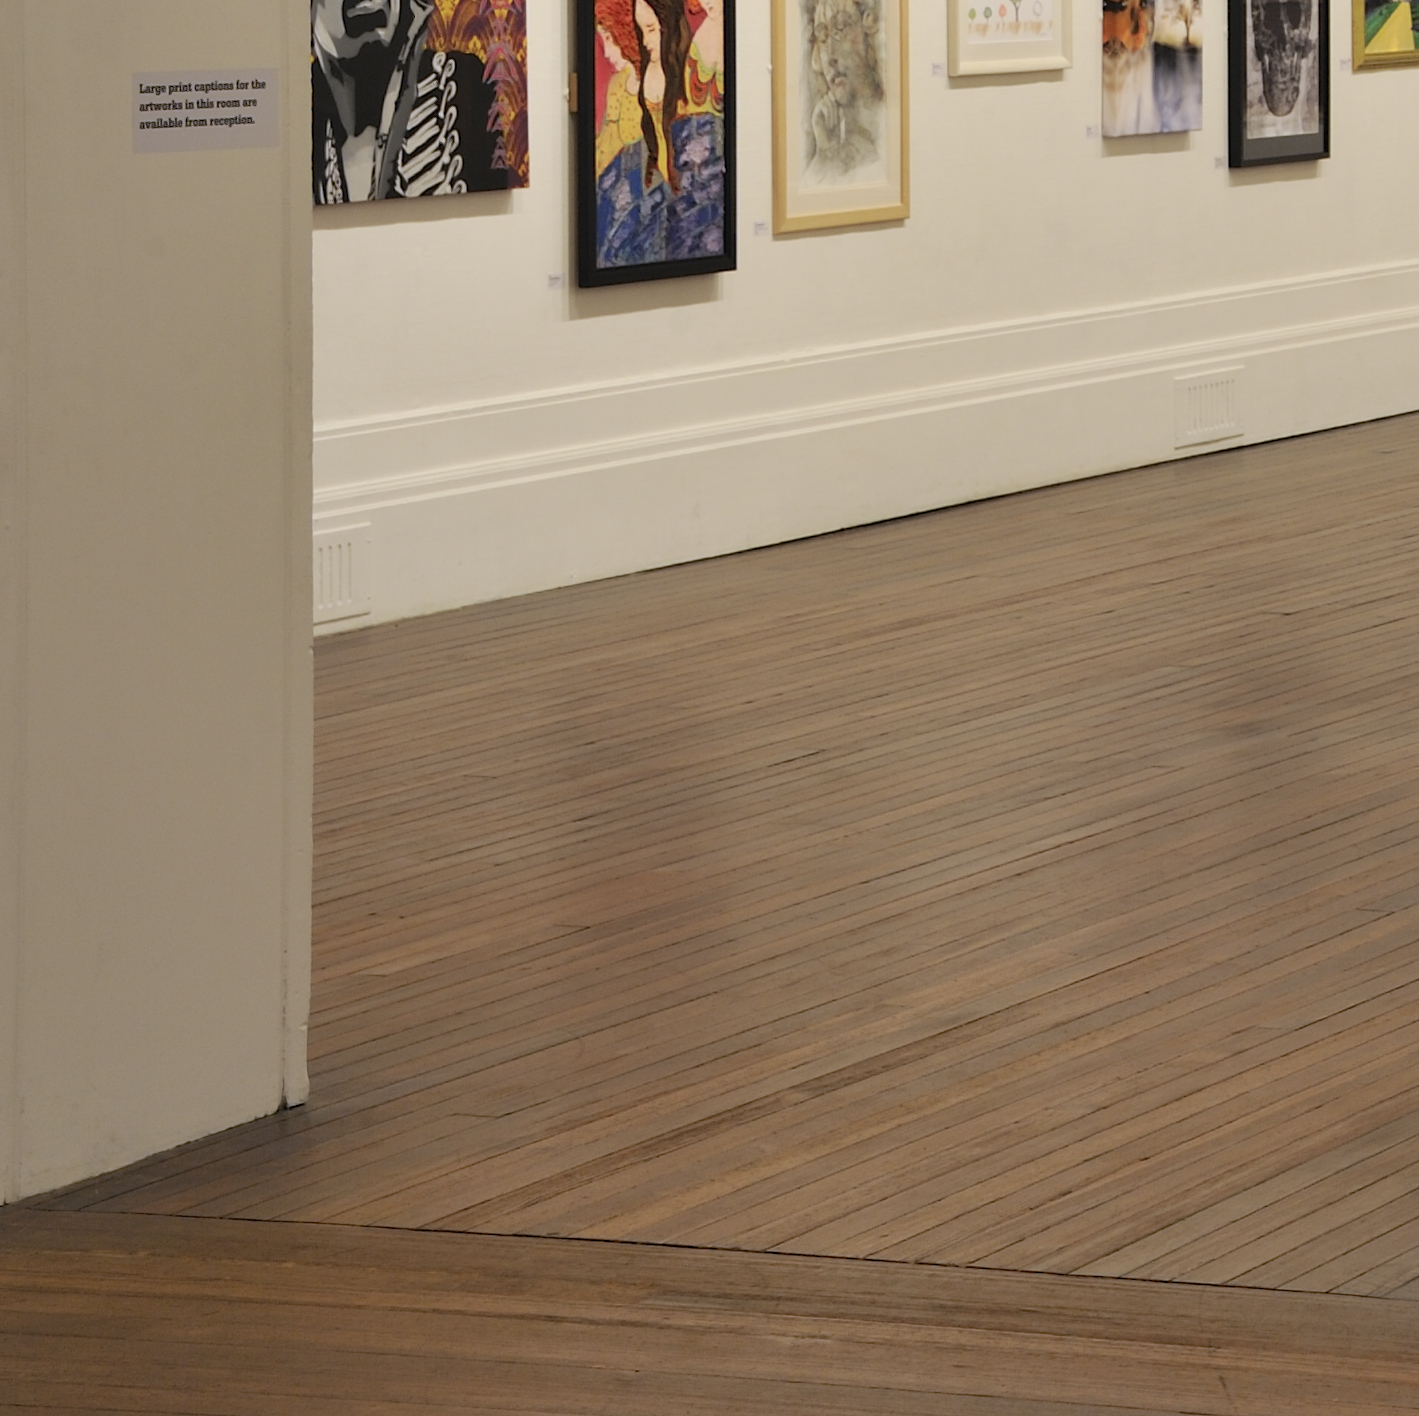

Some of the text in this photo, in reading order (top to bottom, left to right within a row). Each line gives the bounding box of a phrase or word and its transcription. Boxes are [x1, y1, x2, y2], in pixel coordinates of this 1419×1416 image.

[139, 79, 266, 95] Large print captions for the
[139, 98, 257, 112] artworks in this room are
[139, 114, 255, 130] available from reception.
